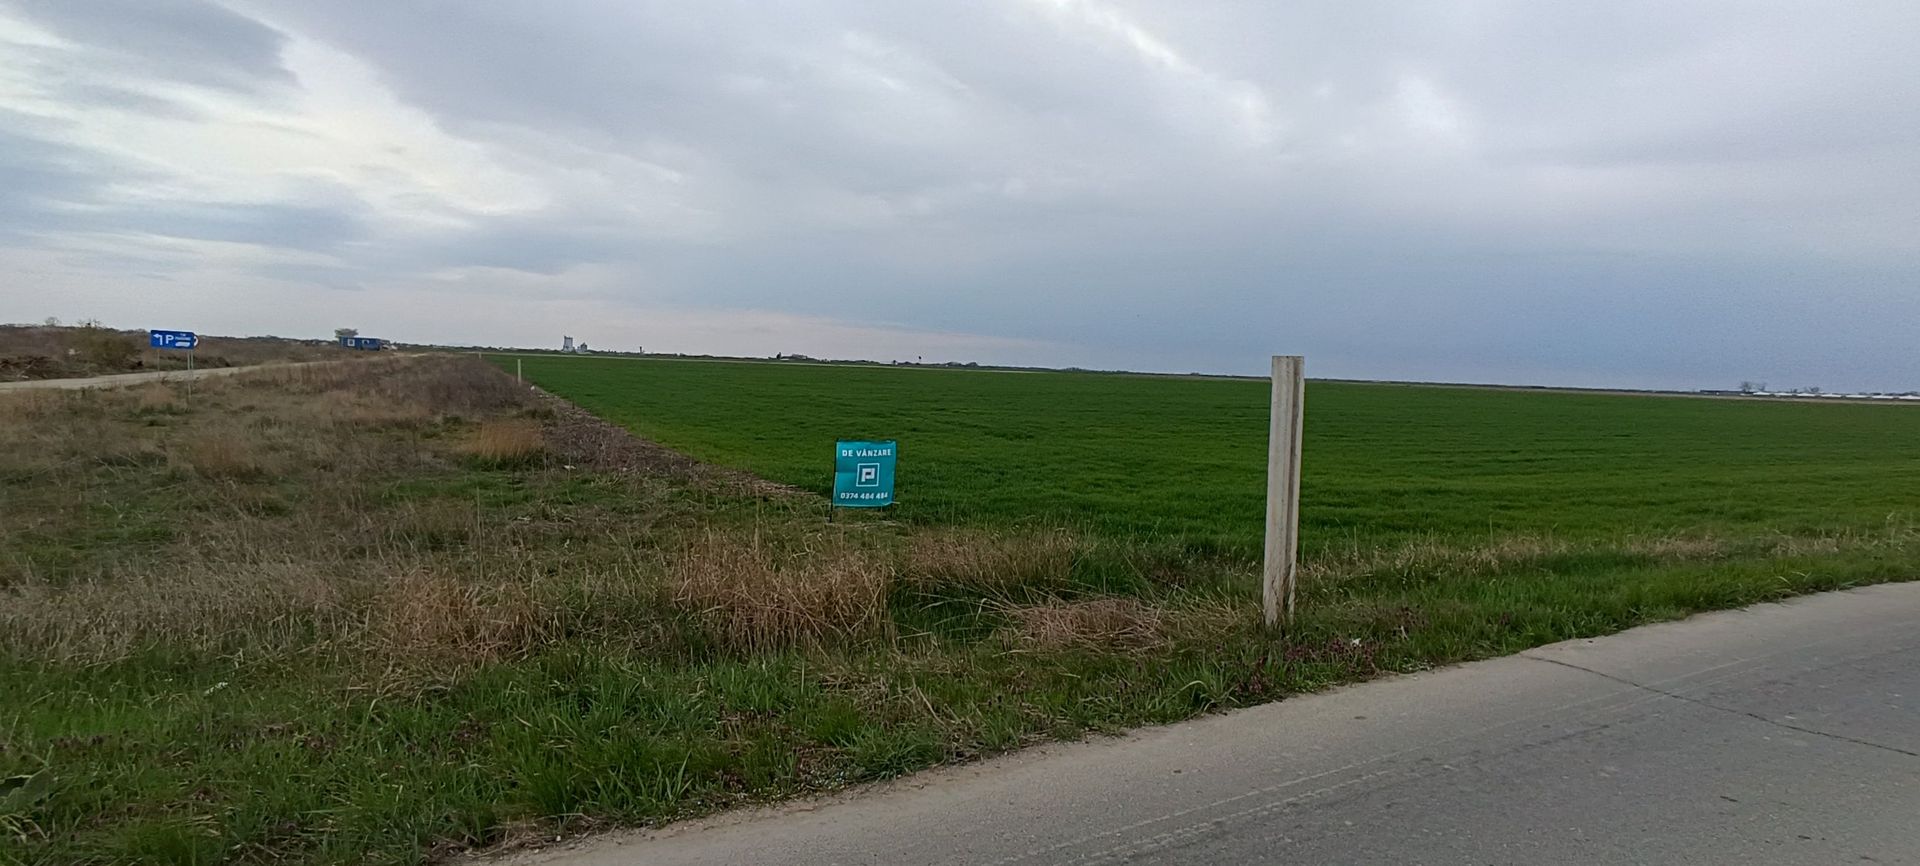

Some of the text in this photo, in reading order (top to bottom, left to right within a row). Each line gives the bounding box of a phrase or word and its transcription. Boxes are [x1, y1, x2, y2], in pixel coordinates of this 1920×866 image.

[165, 334, 175, 345] P
[841, 448, 892, 457] DE VÂNZARE
[861, 467, 876, 482] P
[840, 492, 859, 500] 0374
[860, 492, 875, 500] 484
